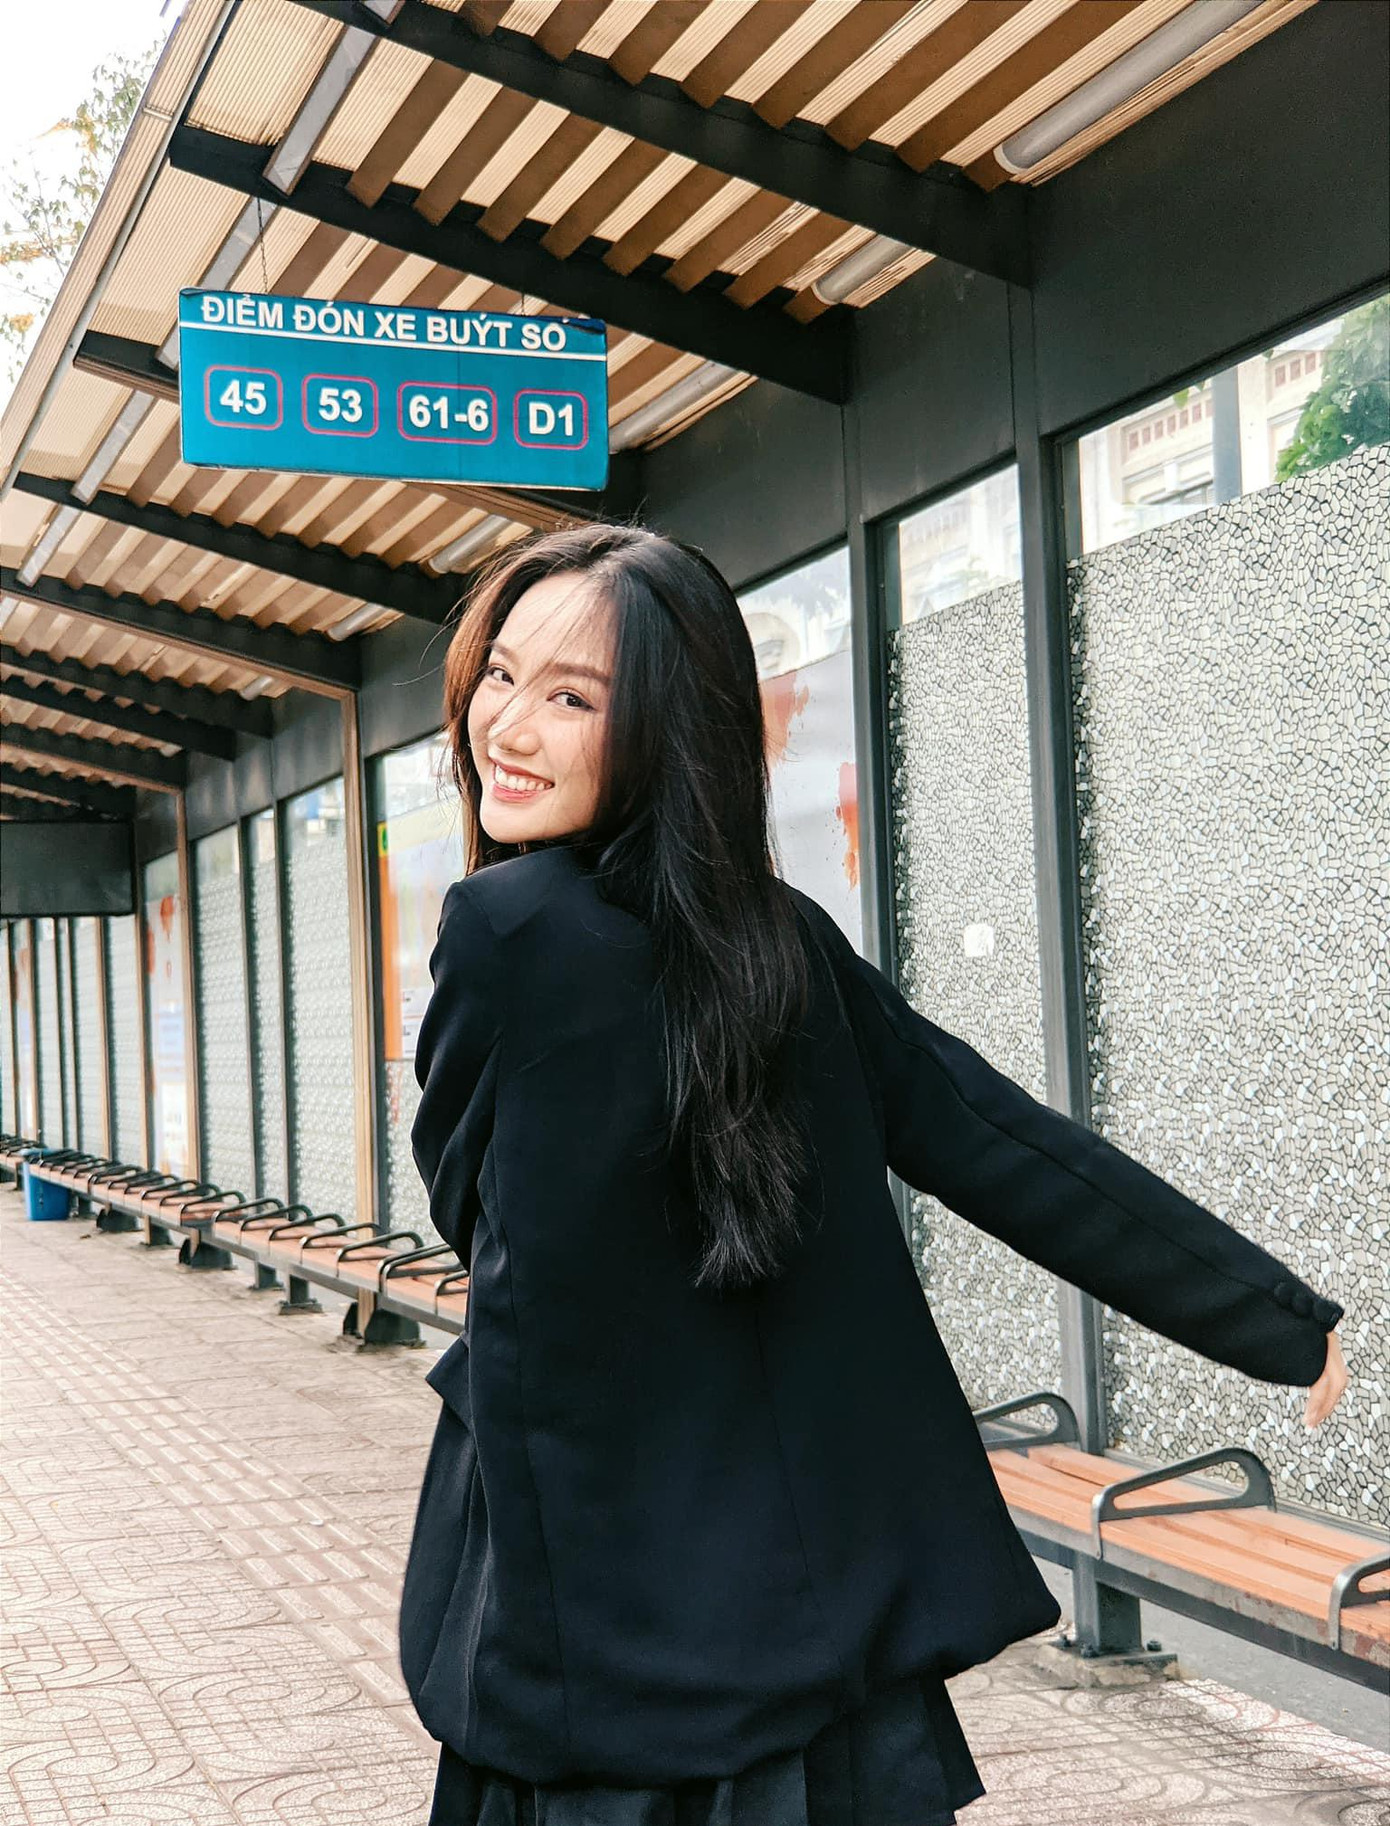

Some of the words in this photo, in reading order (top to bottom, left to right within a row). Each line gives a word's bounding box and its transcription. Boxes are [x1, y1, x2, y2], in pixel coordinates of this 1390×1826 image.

[292, 300, 365, 337] ĐÓN
[374, 311, 417, 341] XE
[426, 313, 513, 348] BUÝT
[219, 380, 267, 414] 45
[318, 387, 363, 423] 53
[408, 395, 489, 432] 61-6
[528, 402, 574, 436] D1
